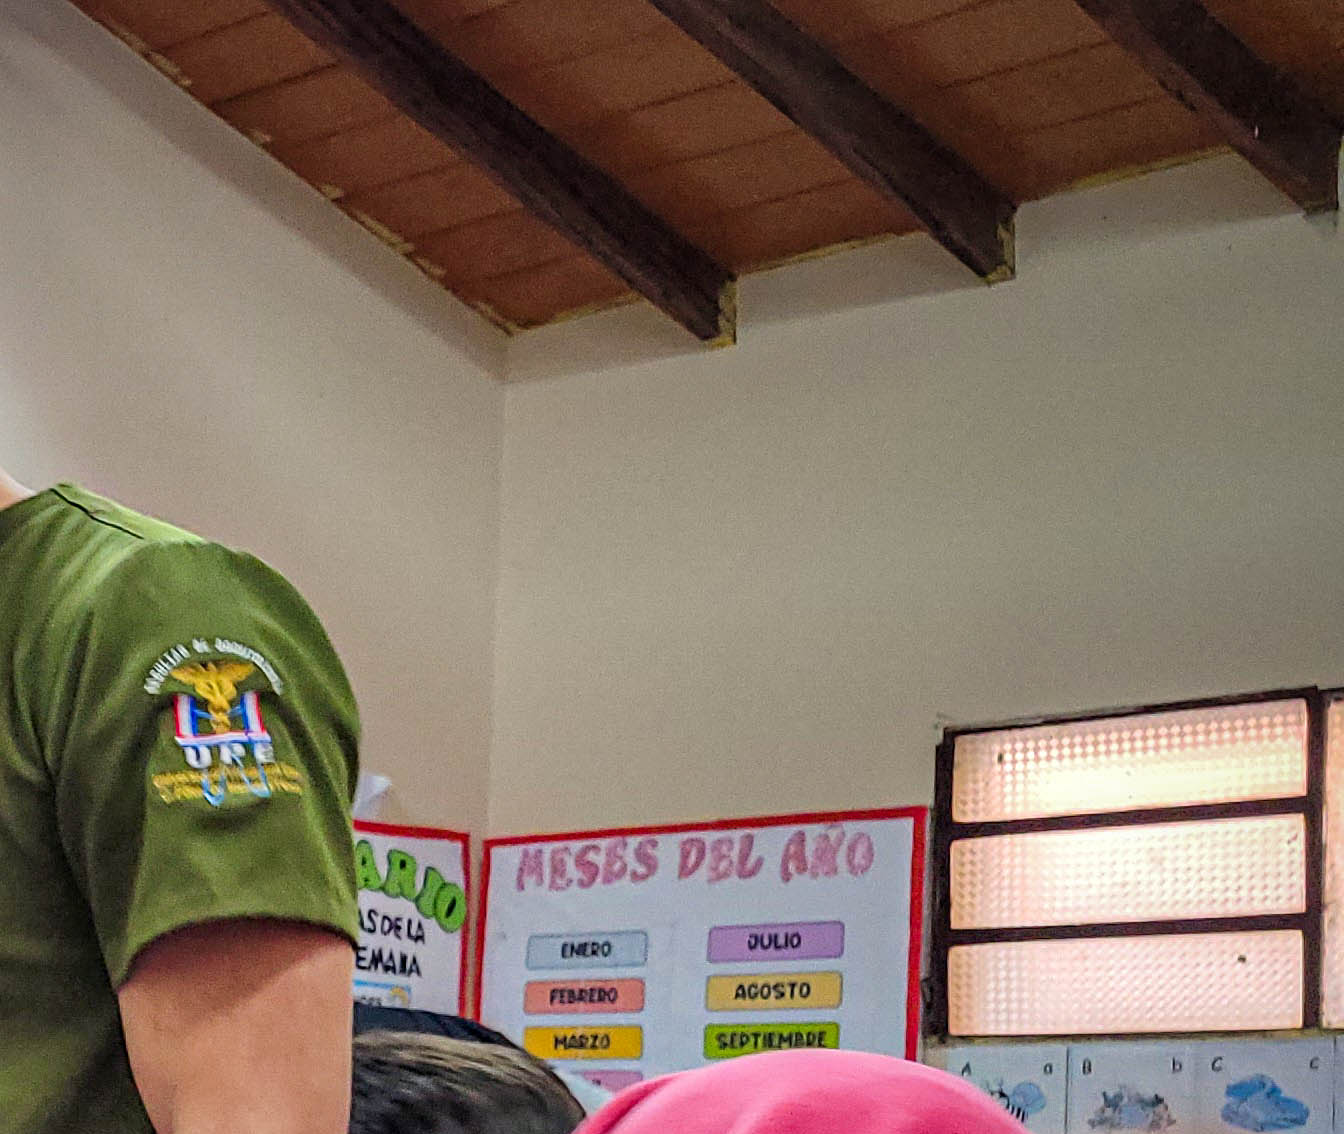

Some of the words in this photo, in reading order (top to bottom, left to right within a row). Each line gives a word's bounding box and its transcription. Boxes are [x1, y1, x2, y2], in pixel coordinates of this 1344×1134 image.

[515, 836, 659, 892] MESES
[676, 832, 765, 885] DEL
[779, 822, 875, 883] AÑO
[561, 939, 612, 960] ENERO
[747, 931, 802, 951] JULIO
[549, 987, 618, 1005] FEBRERO
[733, 980, 812, 1001] AGOSTO
[554, 1033, 611, 1051] MARZO
[714, 1030, 828, 1051] SEPTIEMBRE
[1171, 1056, 1183, 1075] b
